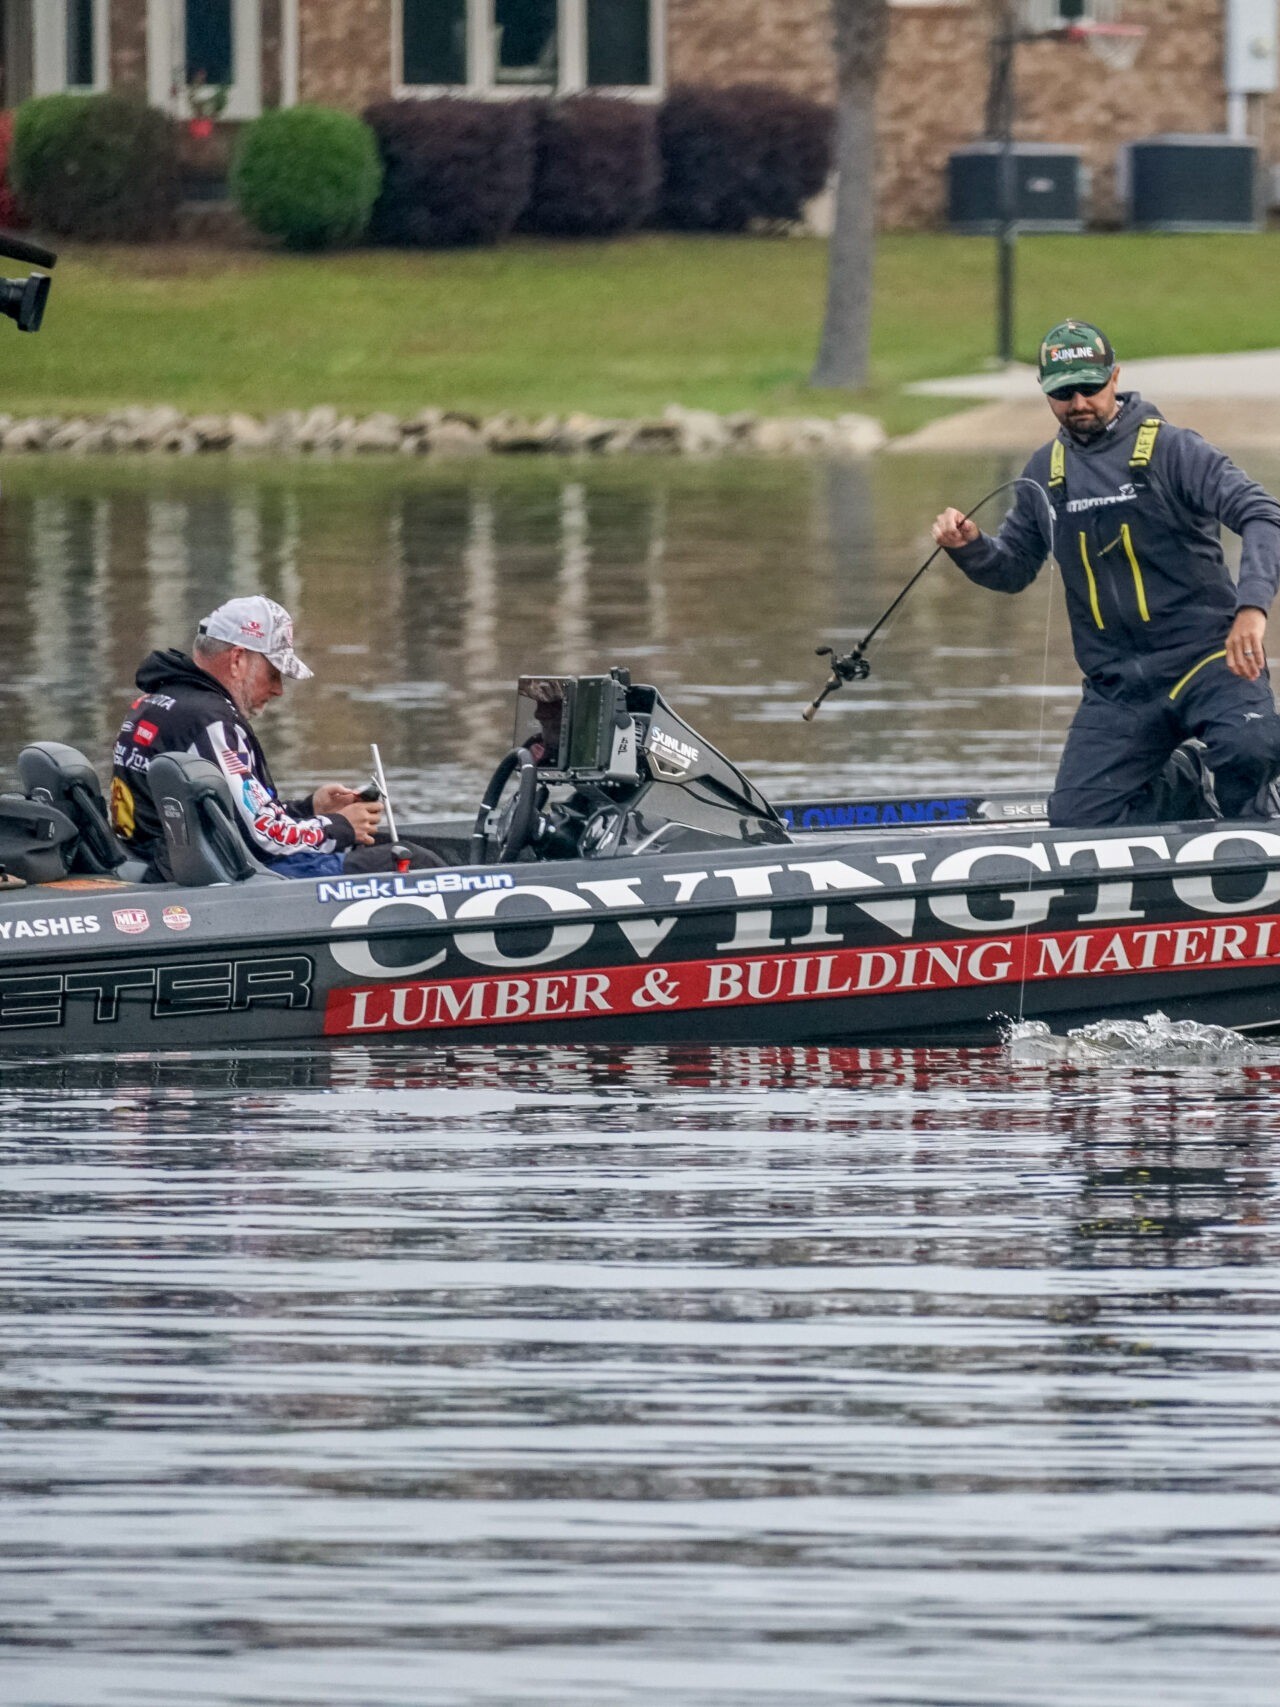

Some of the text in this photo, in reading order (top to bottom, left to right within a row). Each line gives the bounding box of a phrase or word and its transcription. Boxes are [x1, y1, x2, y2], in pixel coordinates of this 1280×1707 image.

[1051, 346, 1094, 361] SUNLINE
[651, 726, 700, 763] SUNLINE
[784, 798, 969, 830] LOWRANCE
[318, 877, 393, 903] Nick
[0, 915, 101, 940] YASHES
[114, 911, 148, 927] MLF
[347, 973, 613, 1031] LUMBER
[631, 967, 681, 1010] &
[702, 941, 1013, 1004] BUILDING
